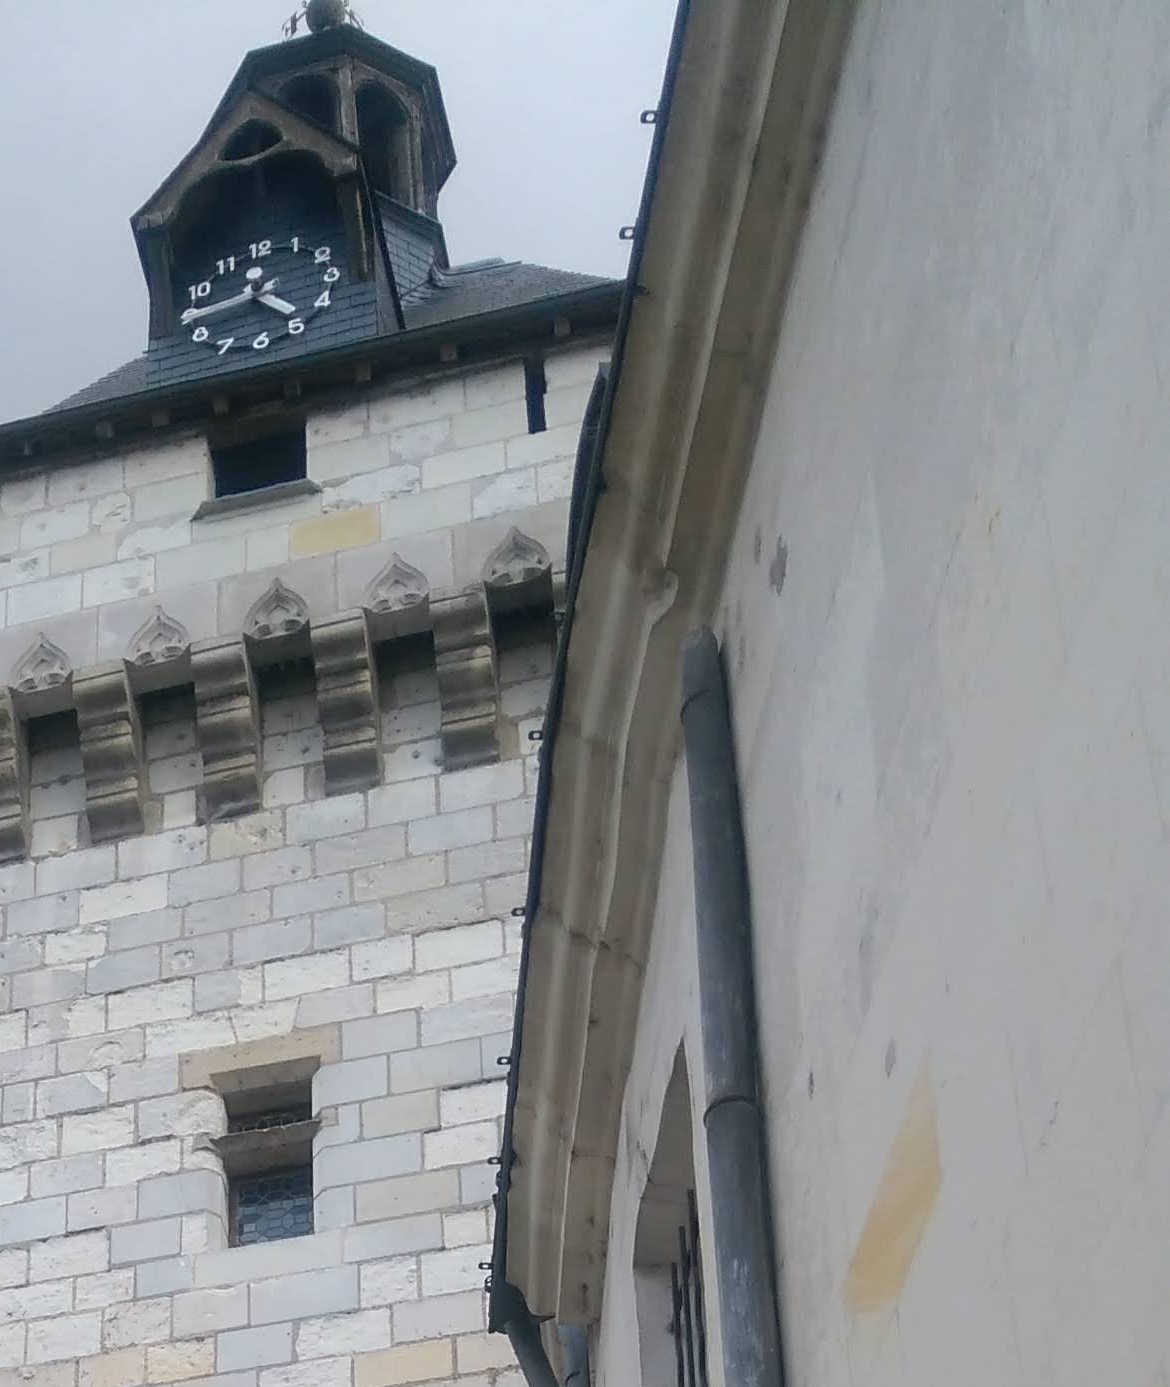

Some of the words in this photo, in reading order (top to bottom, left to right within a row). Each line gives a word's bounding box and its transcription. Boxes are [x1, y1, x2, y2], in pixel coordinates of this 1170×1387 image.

[249, 239, 272, 259] 12
[290, 237, 300, 252] 1
[314, 246, 331, 264] 2
[215, 255, 236, 275] 11
[323, 267, 341, 283] 3
[188, 281, 211, 300] 10
[314, 290, 332, 308] 4
[192, 326, 209, 343] 8
[288, 318, 305, 335] 5
[216, 337, 235, 356] 7
[252, 331, 270, 350] 6
